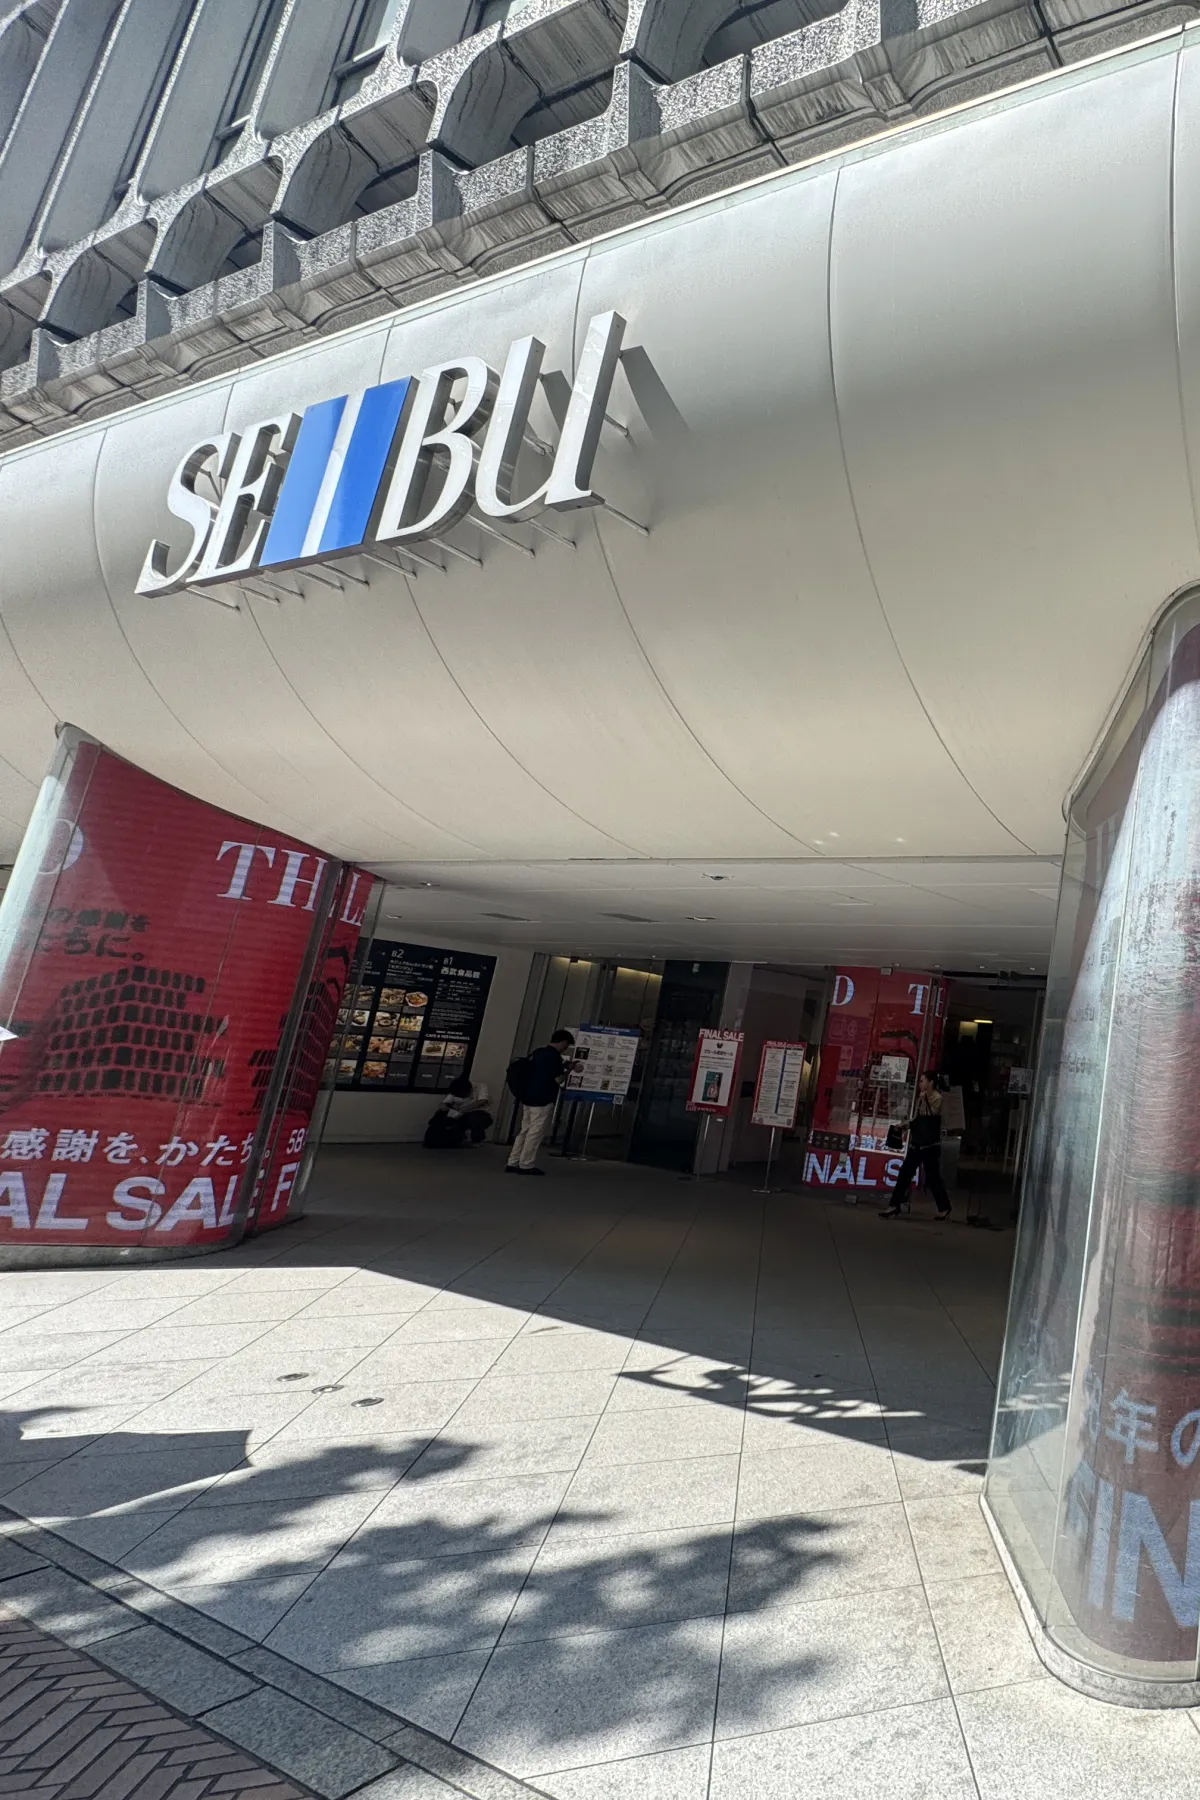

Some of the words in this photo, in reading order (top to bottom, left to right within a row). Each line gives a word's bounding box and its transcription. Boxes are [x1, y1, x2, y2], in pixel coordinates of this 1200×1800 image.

[135, 310, 626, 597] SEIBU
[698, 1028, 722, 1040] FINAL
[722, 1031, 745, 1042] SALE
